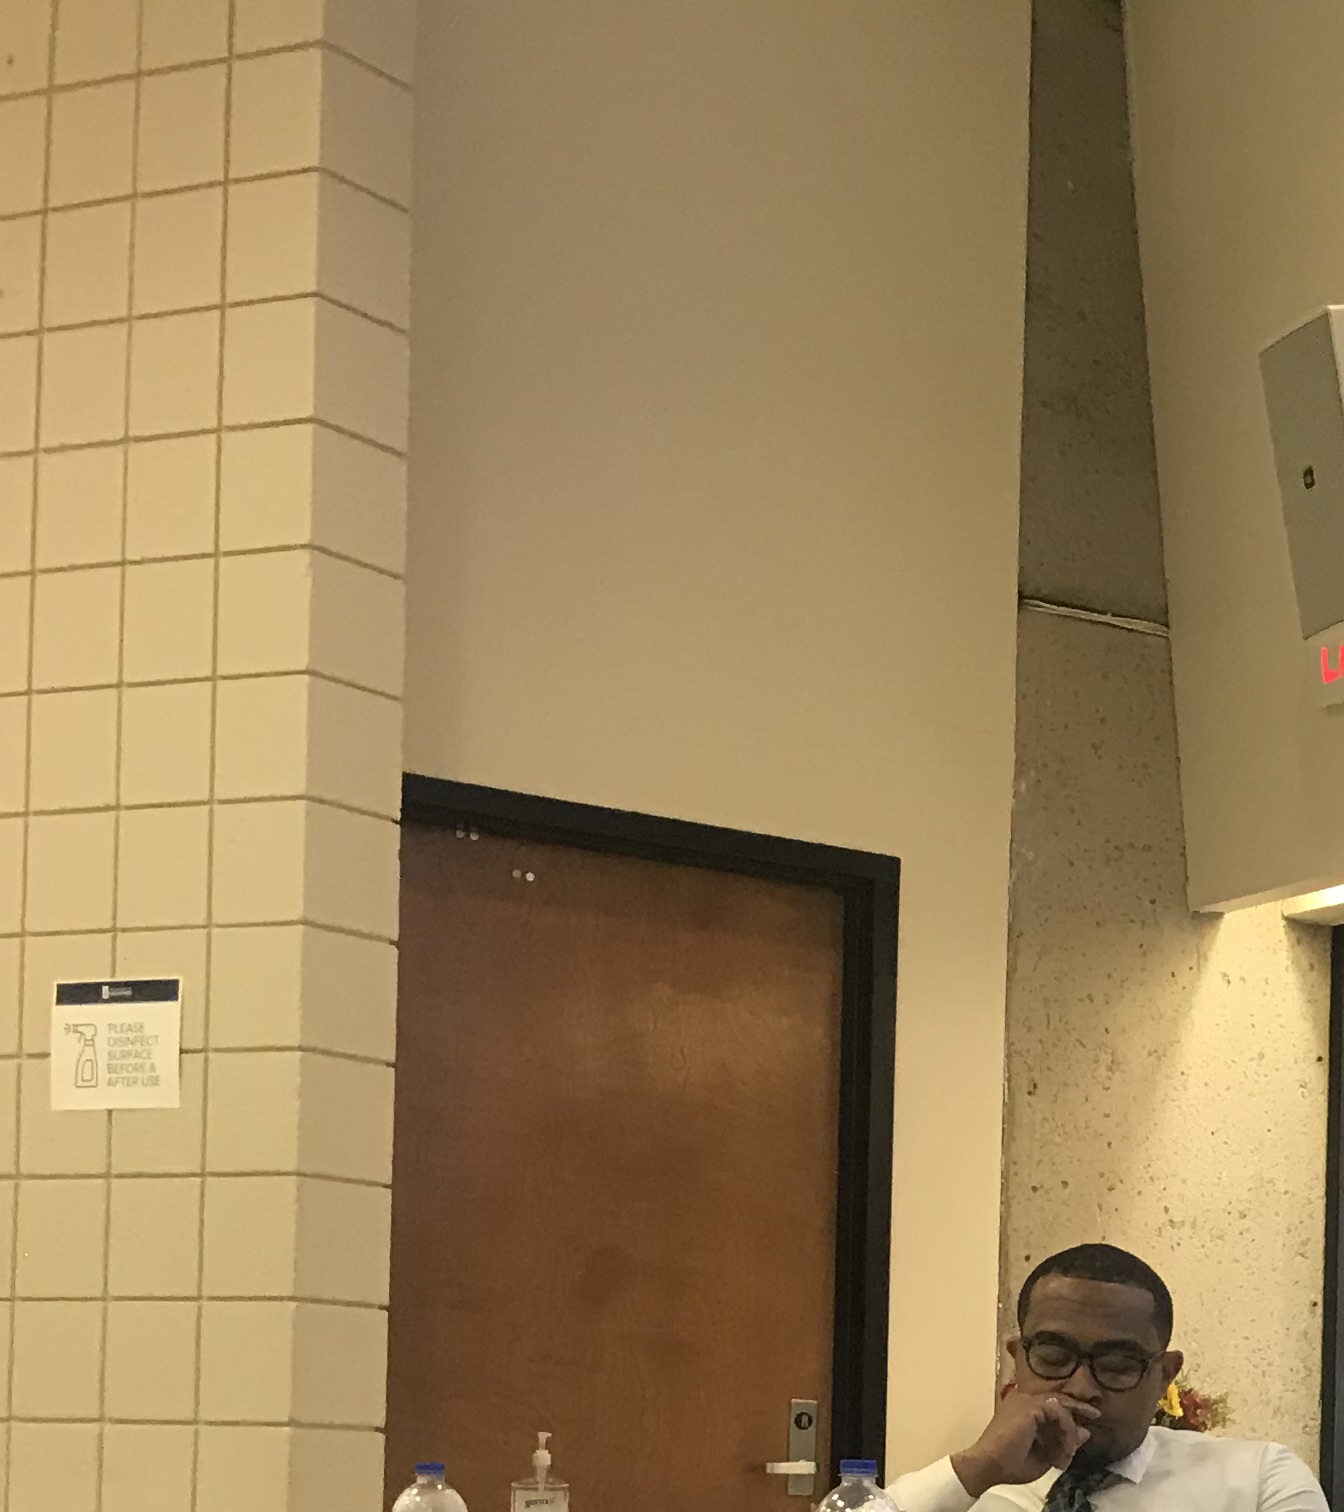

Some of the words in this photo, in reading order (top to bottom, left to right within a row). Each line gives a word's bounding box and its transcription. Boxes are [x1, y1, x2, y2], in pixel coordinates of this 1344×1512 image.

[107, 1021, 145, 1034] PLEASE
[107, 1034, 160, 1048] DISINFECT
[107, 1048, 153, 1061] SURFACE
[106, 1062, 147, 1074] BEFORE
[107, 1076, 139, 1088] AFTER
[141, 1075, 161, 1087] USE
